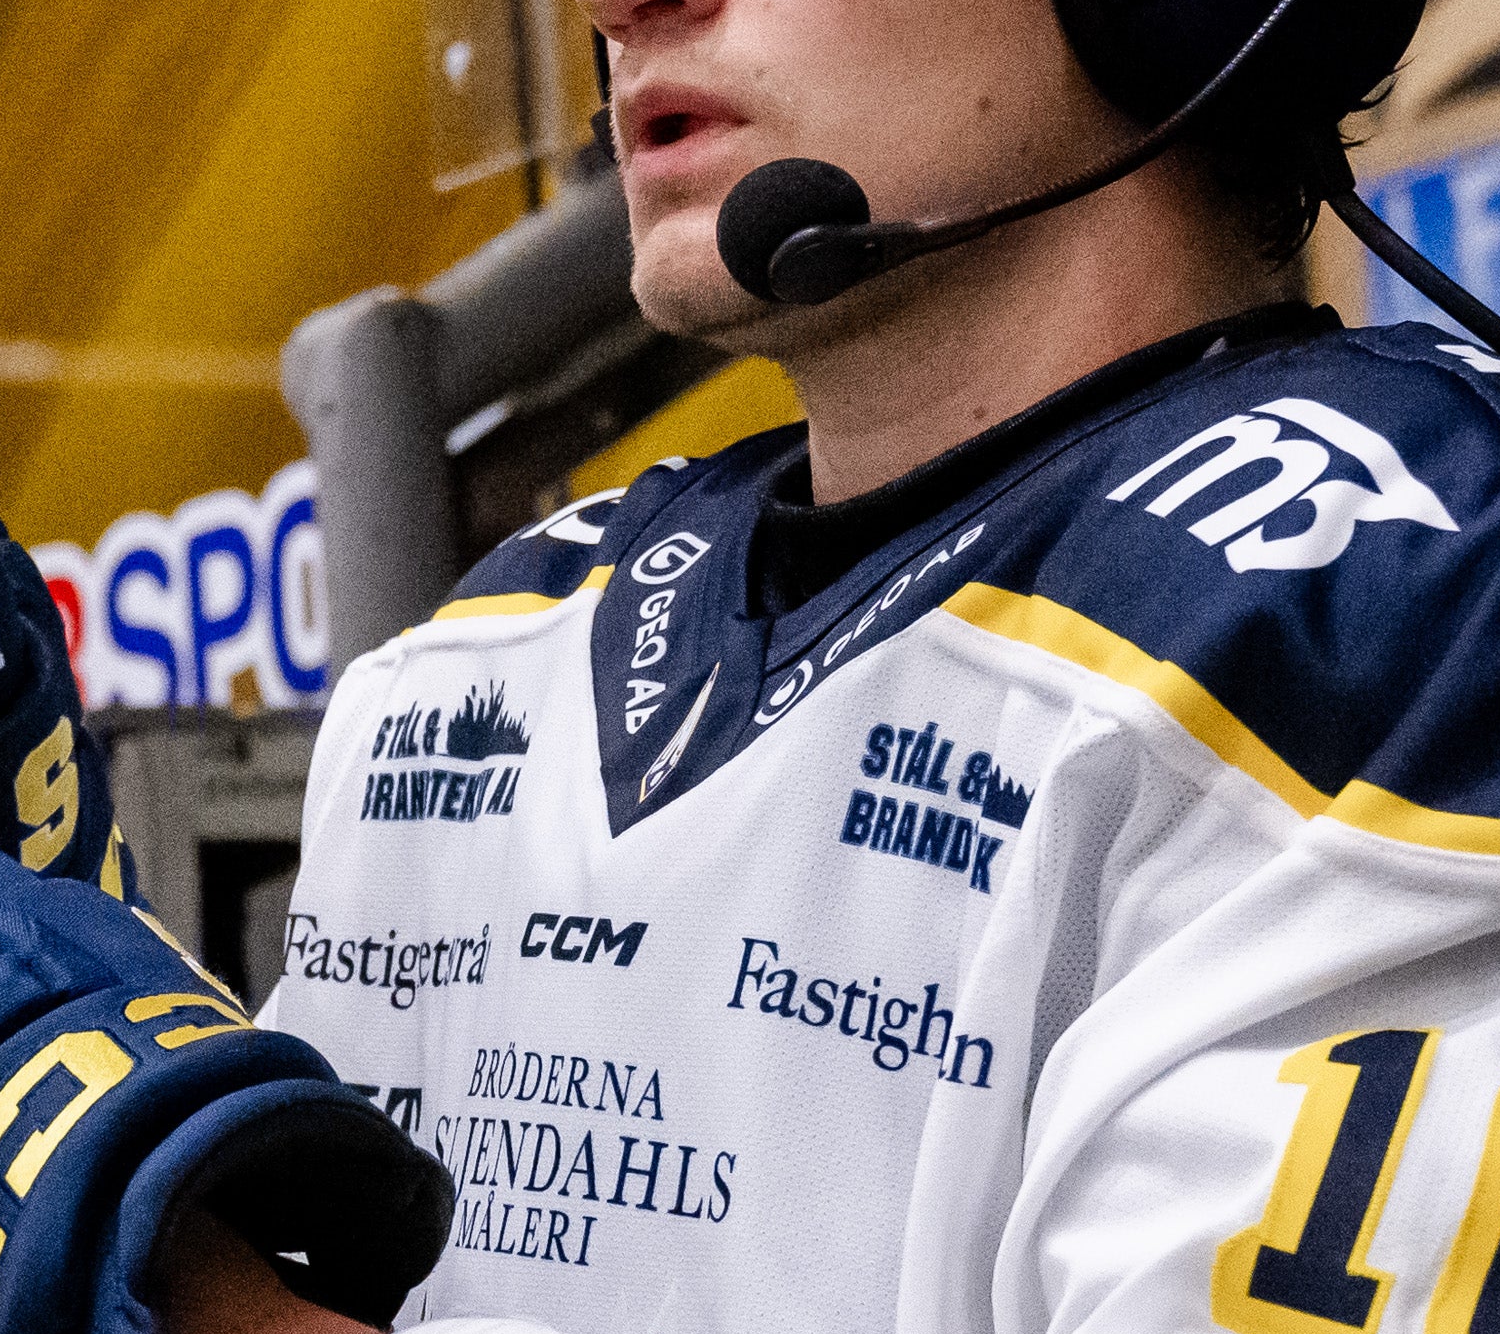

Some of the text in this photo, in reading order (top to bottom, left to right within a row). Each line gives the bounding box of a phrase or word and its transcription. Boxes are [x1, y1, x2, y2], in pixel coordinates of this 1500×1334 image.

[635, 589, 676, 669] GEO
[824, 574, 913, 667] GEO
[859, 720, 992, 807] STÅL &
[520, 912, 649, 967] CCM
[467, 1041, 665, 1121] BRÖDERNA
[454, 1190, 599, 1267] MÅLERI
